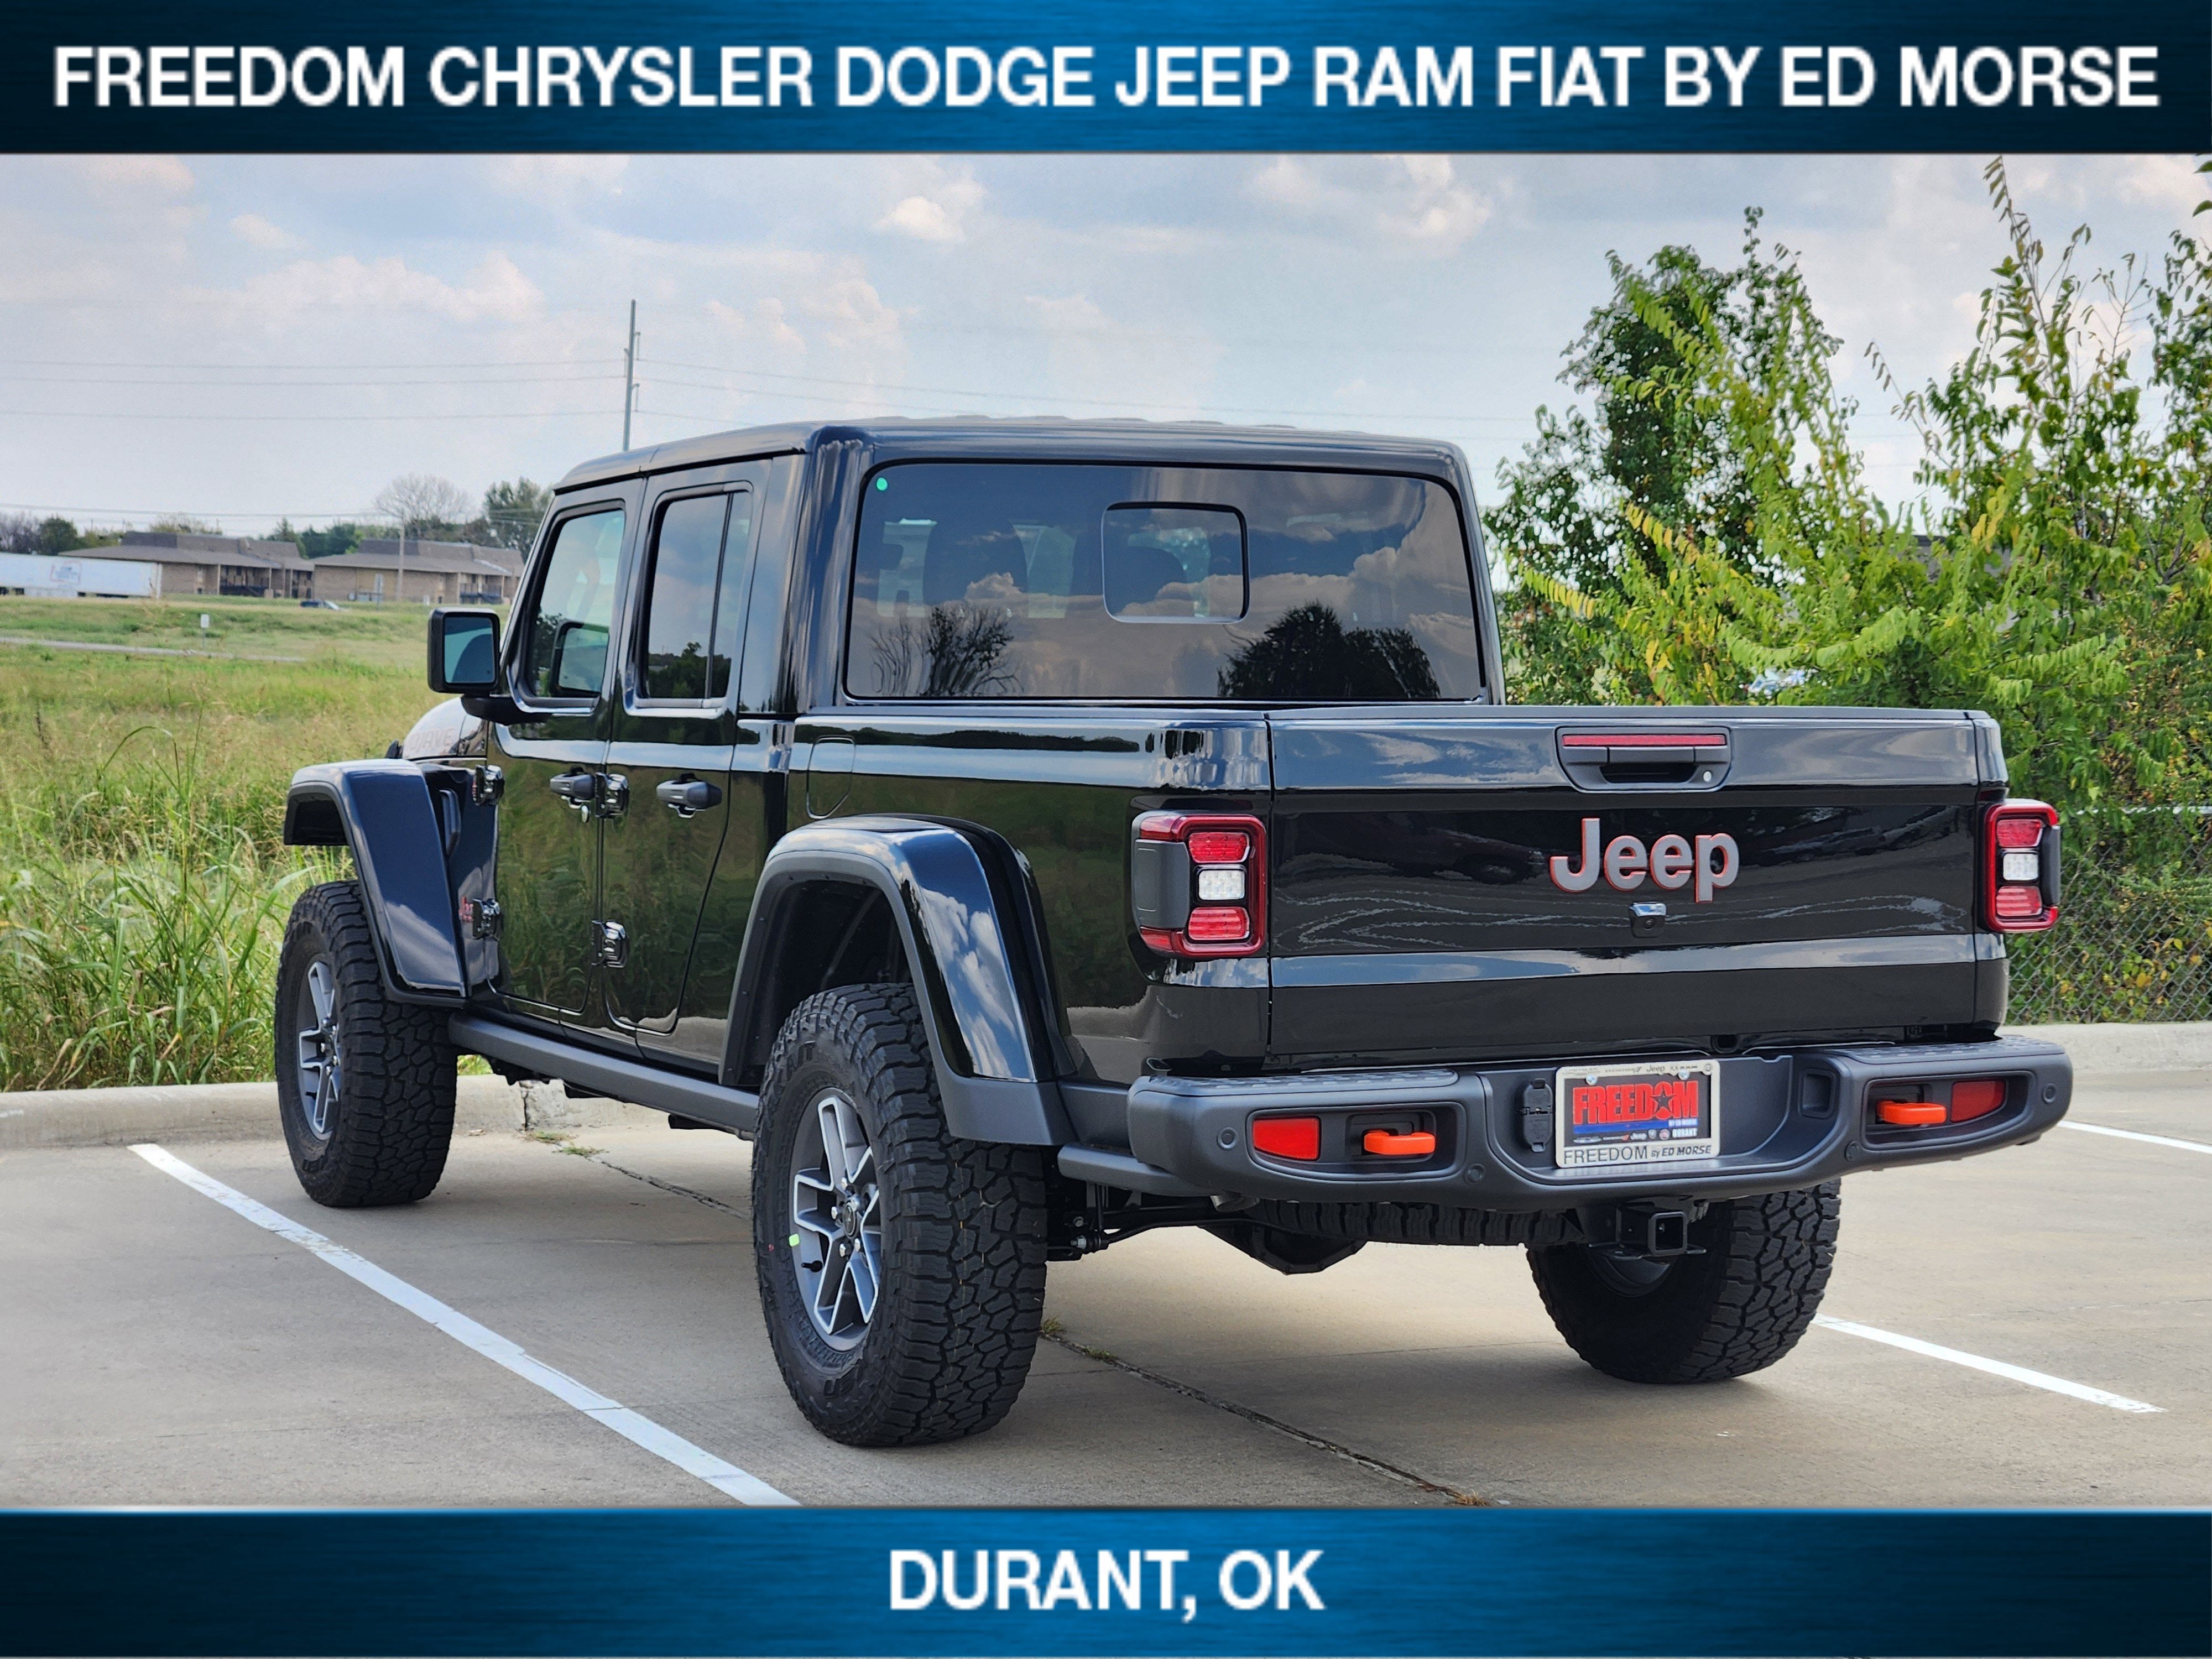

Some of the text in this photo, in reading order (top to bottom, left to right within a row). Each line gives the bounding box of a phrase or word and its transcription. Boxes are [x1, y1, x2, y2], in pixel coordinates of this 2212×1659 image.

[1550, 817, 1739, 902] Jeep
[1573, 1081, 1698, 1124] FREEDOM
[1563, 1145, 1647, 1164] FREEDOM
[1662, 1147, 1674, 1157] ED
[1677, 1145, 1712, 1156] MORSE
